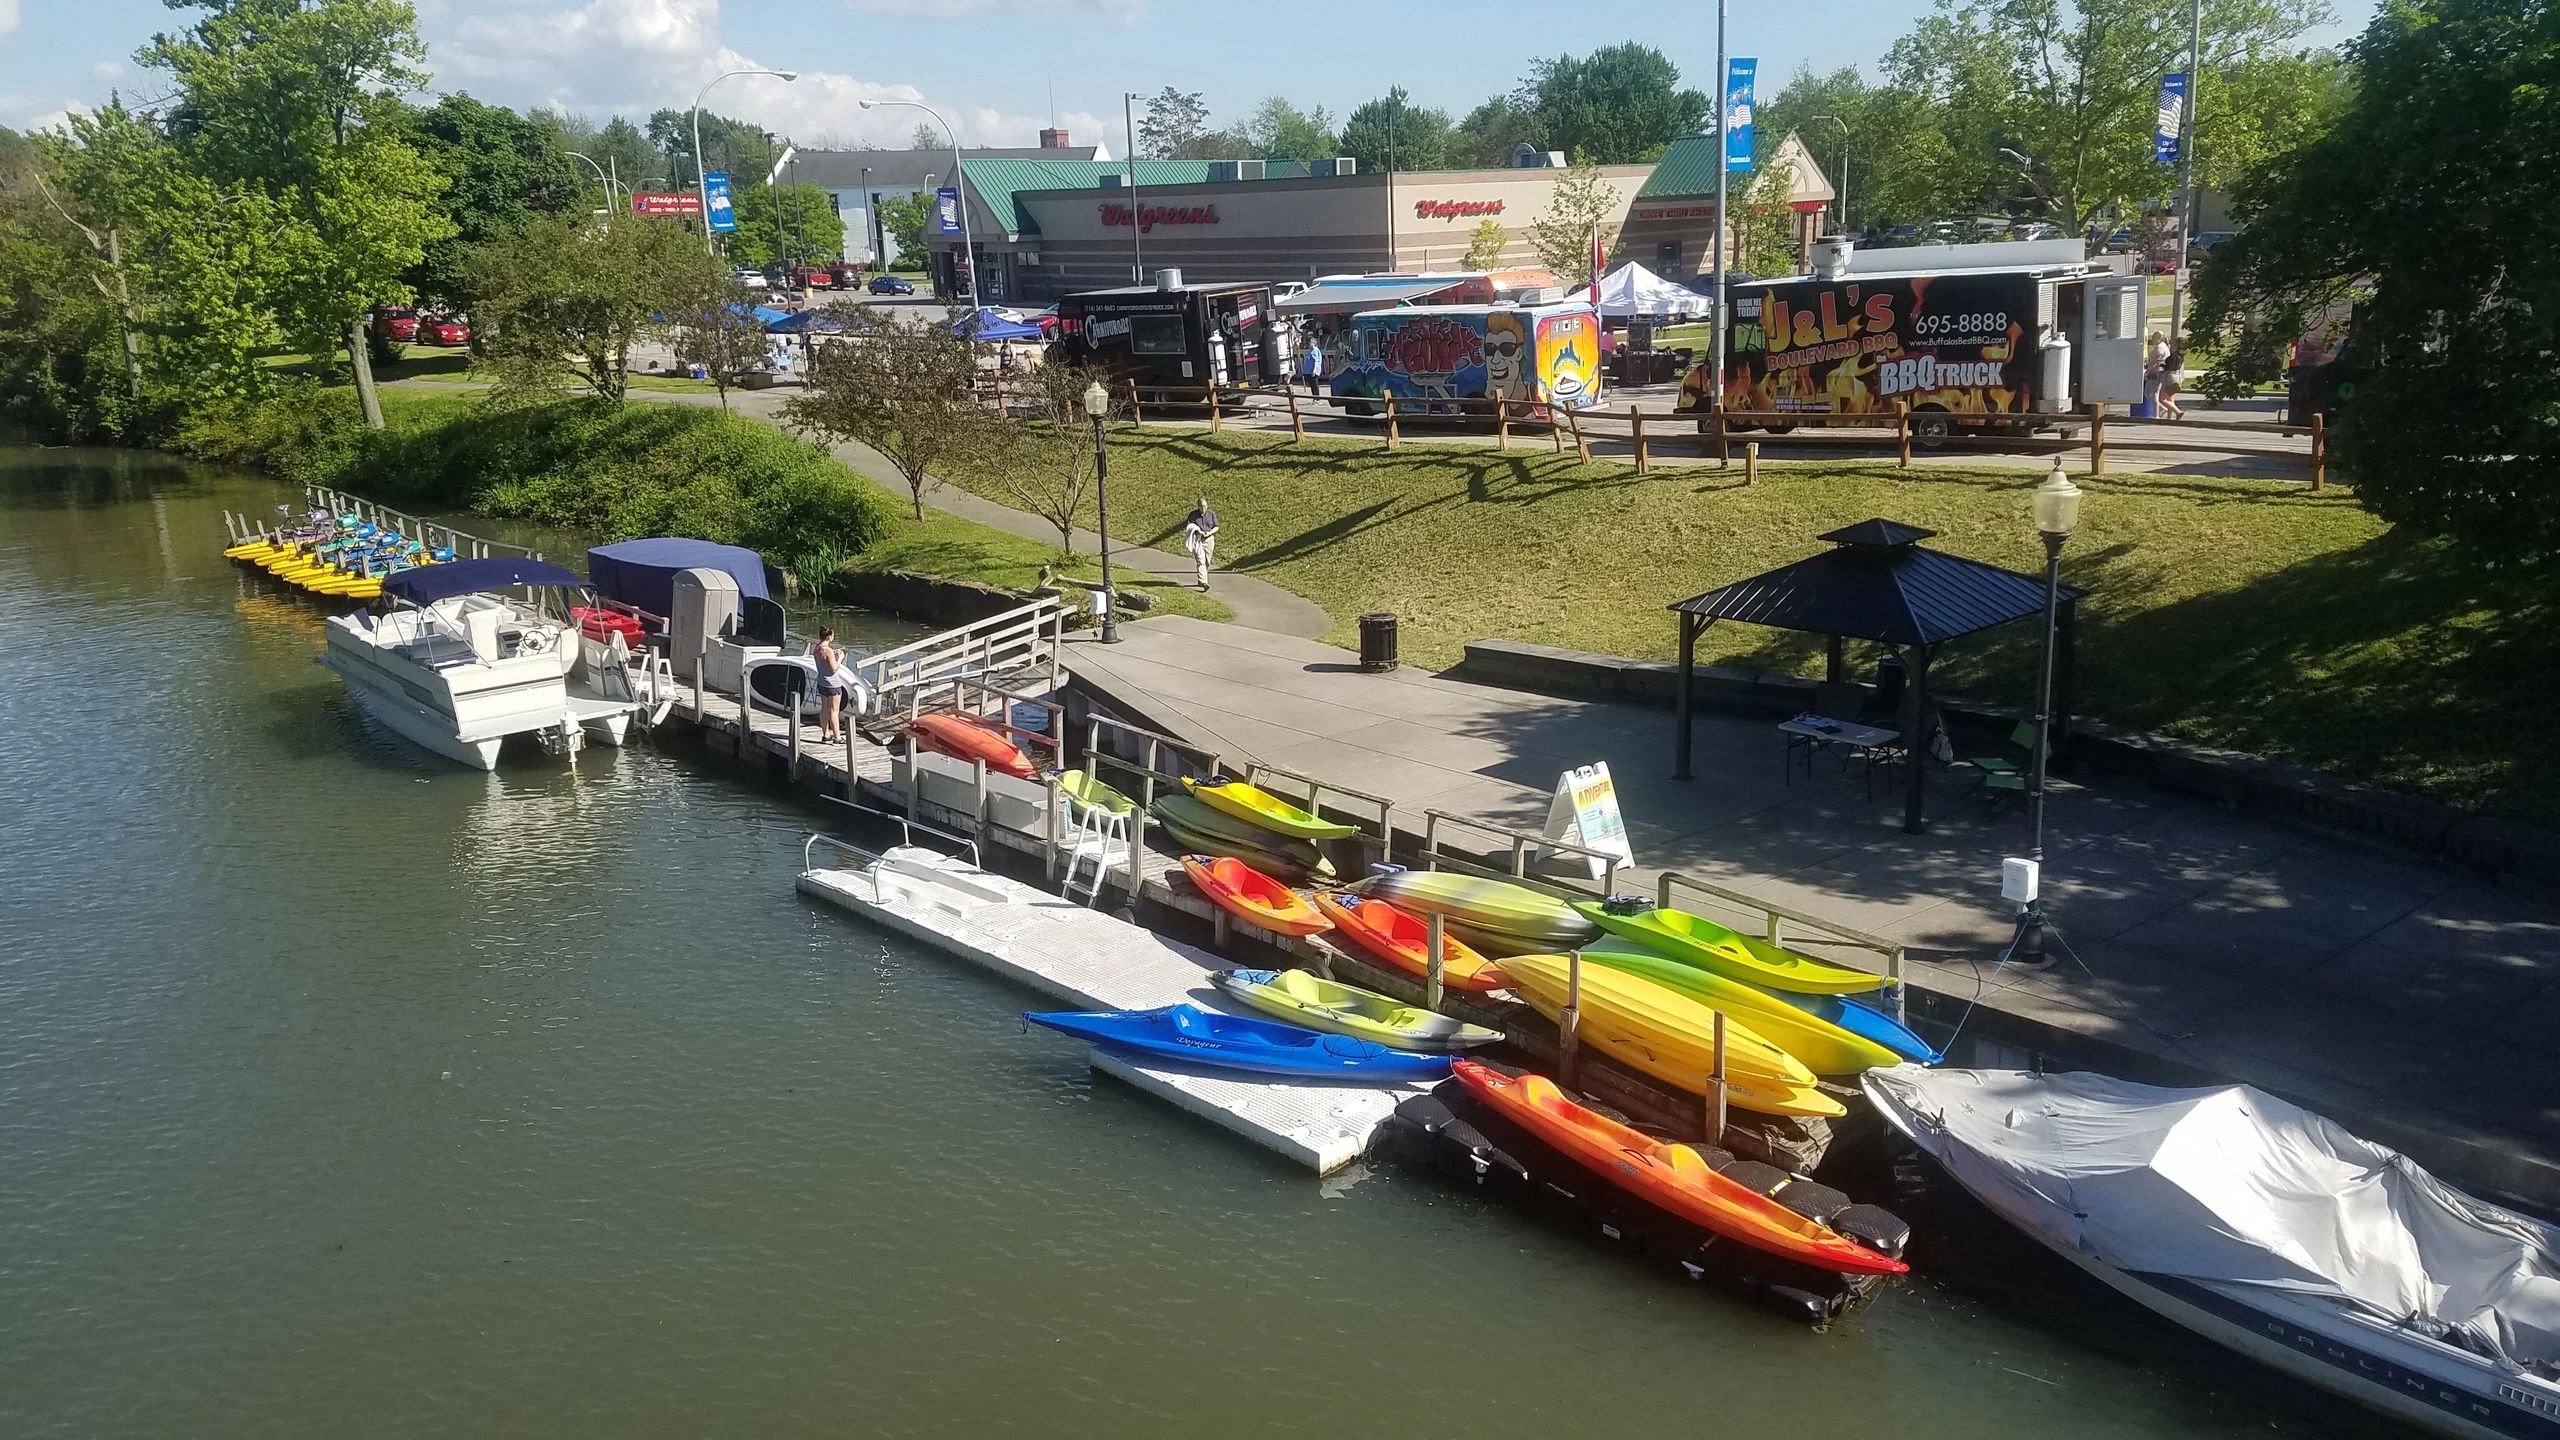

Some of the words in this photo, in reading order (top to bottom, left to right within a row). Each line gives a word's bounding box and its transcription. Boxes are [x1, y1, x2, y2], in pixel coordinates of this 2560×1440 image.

[1413, 199, 1507, 224] Walgreens
[1736, 306, 1763, 318] TODAY!
[1915, 312, 2007, 335] 695-8888
[1766, 338, 1861, 372] BOULEVARD
[1862, 331, 1899, 354] BBQ
[1909, 335, 2007, 347] www.BuffalosBestBBQ.com
